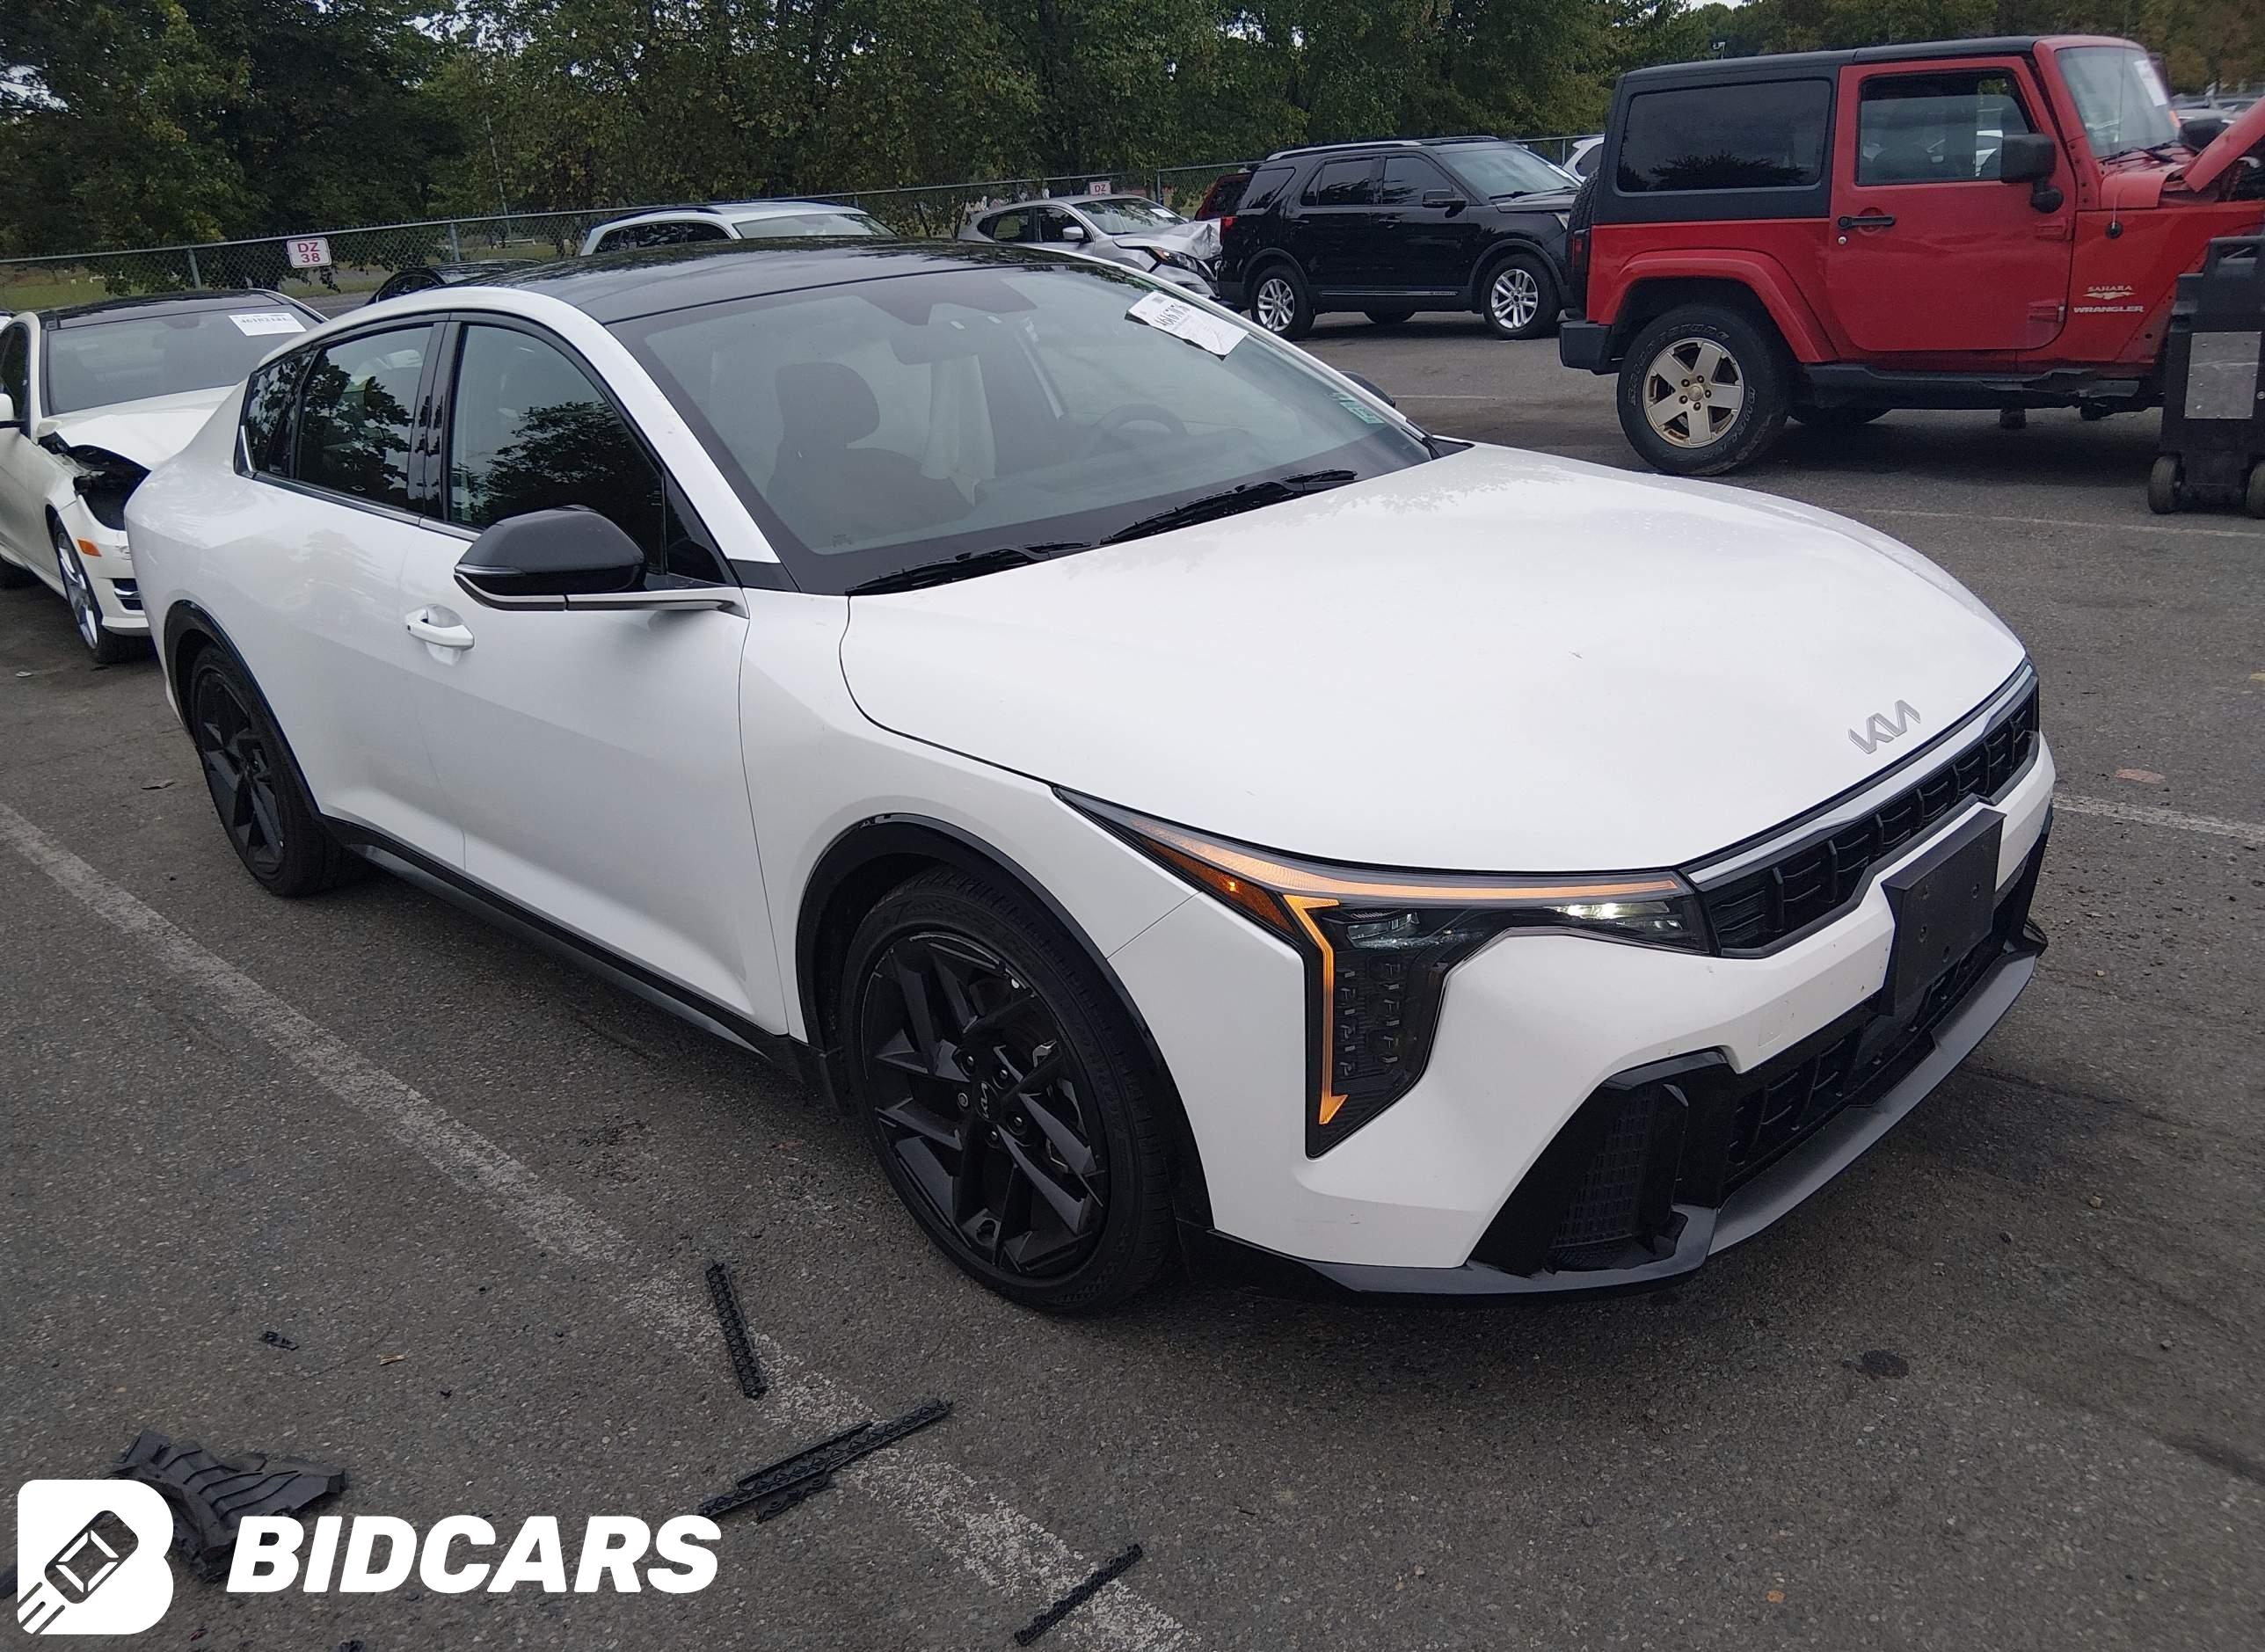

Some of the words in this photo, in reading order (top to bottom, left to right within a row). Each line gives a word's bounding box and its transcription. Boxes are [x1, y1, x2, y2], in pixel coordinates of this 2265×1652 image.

[297, 242, 320, 252] DZ
[301, 252, 320, 263] 38
[1848, 699, 1921, 754] KIA
